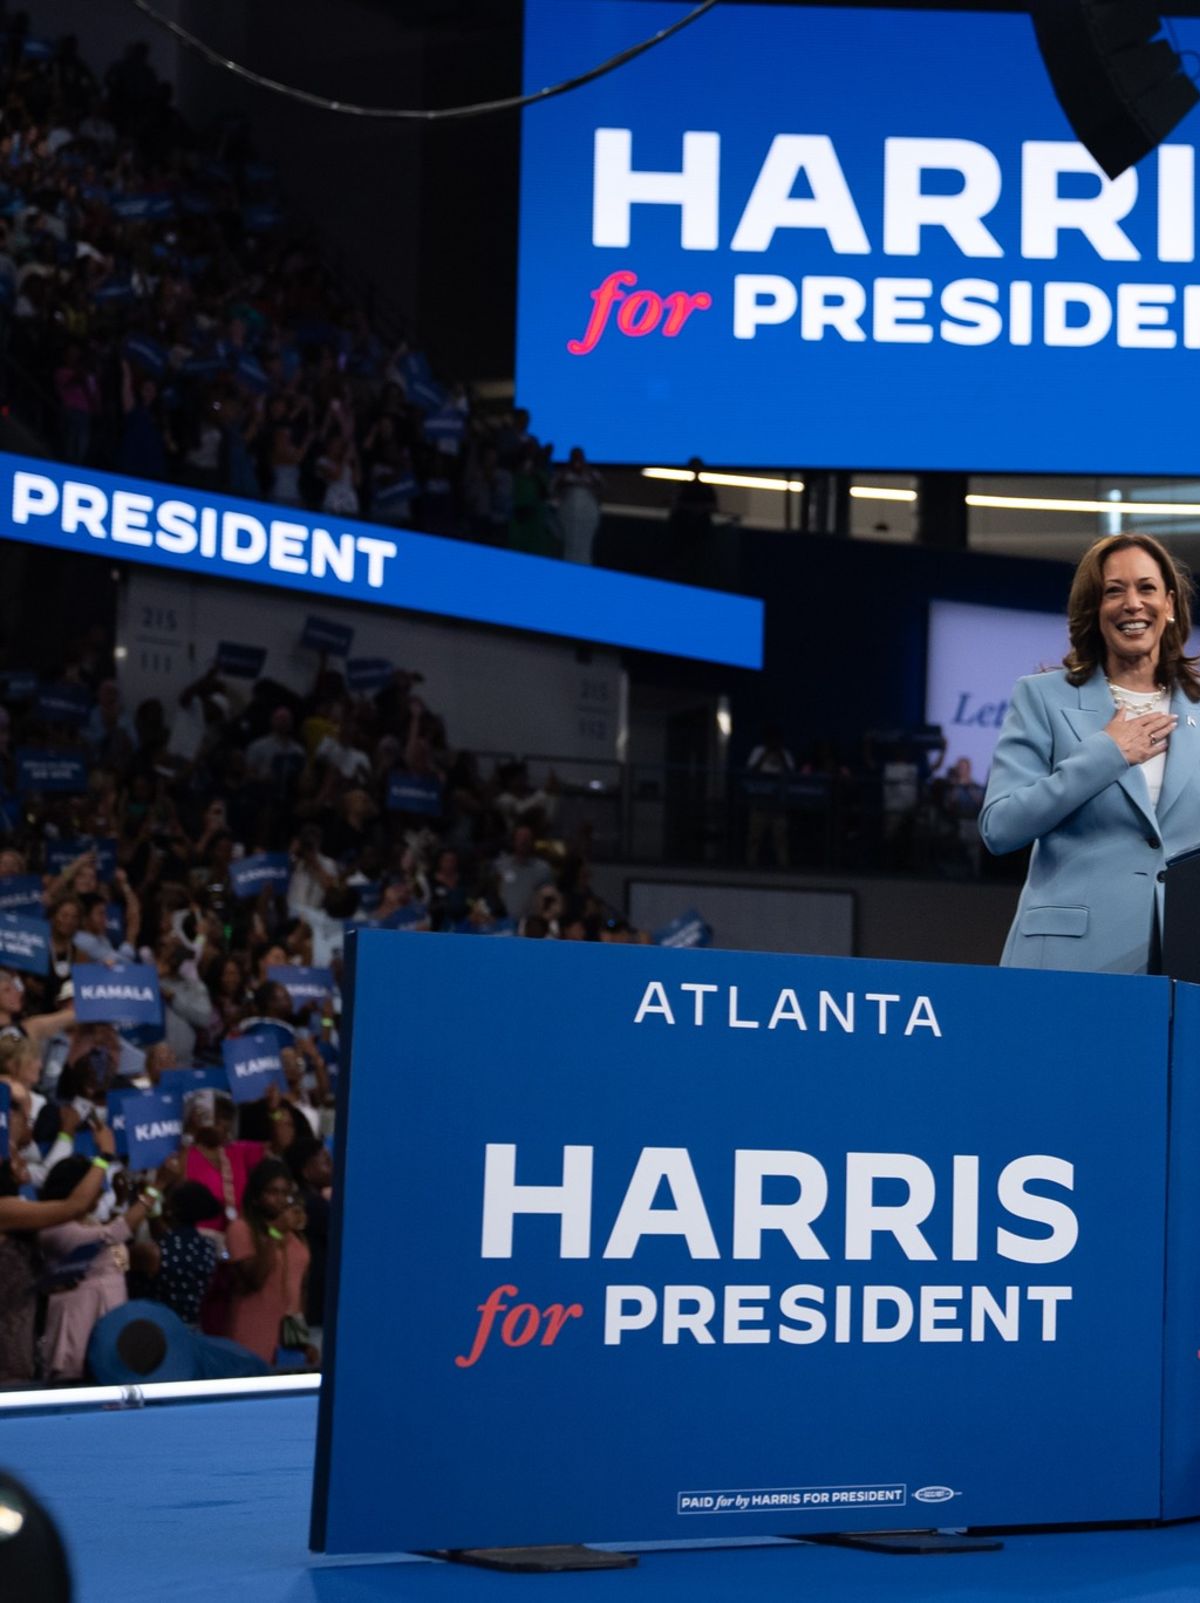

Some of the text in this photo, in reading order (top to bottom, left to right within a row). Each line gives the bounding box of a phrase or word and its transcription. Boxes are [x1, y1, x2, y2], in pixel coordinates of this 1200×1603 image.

[566, 270, 713, 356] for
[12, 471, 397, 588] PRESIDENT
[80, 983, 154, 1004] KAMALA
[634, 981, 942, 1037] ATLANTA
[481, 1143, 1079, 1264] HARRIS
[455, 1284, 1073, 1367] for PRESIDENT
[681, 1496, 713, 1508] PAID
[714, 1495, 734, 1510] for
[735, 1494, 750, 1510] by
[752, 1493, 801, 1506] HARRIS
[803, 1492, 830, 1503] FOR
[832, 1489, 902, 1503] PRESIDENT
